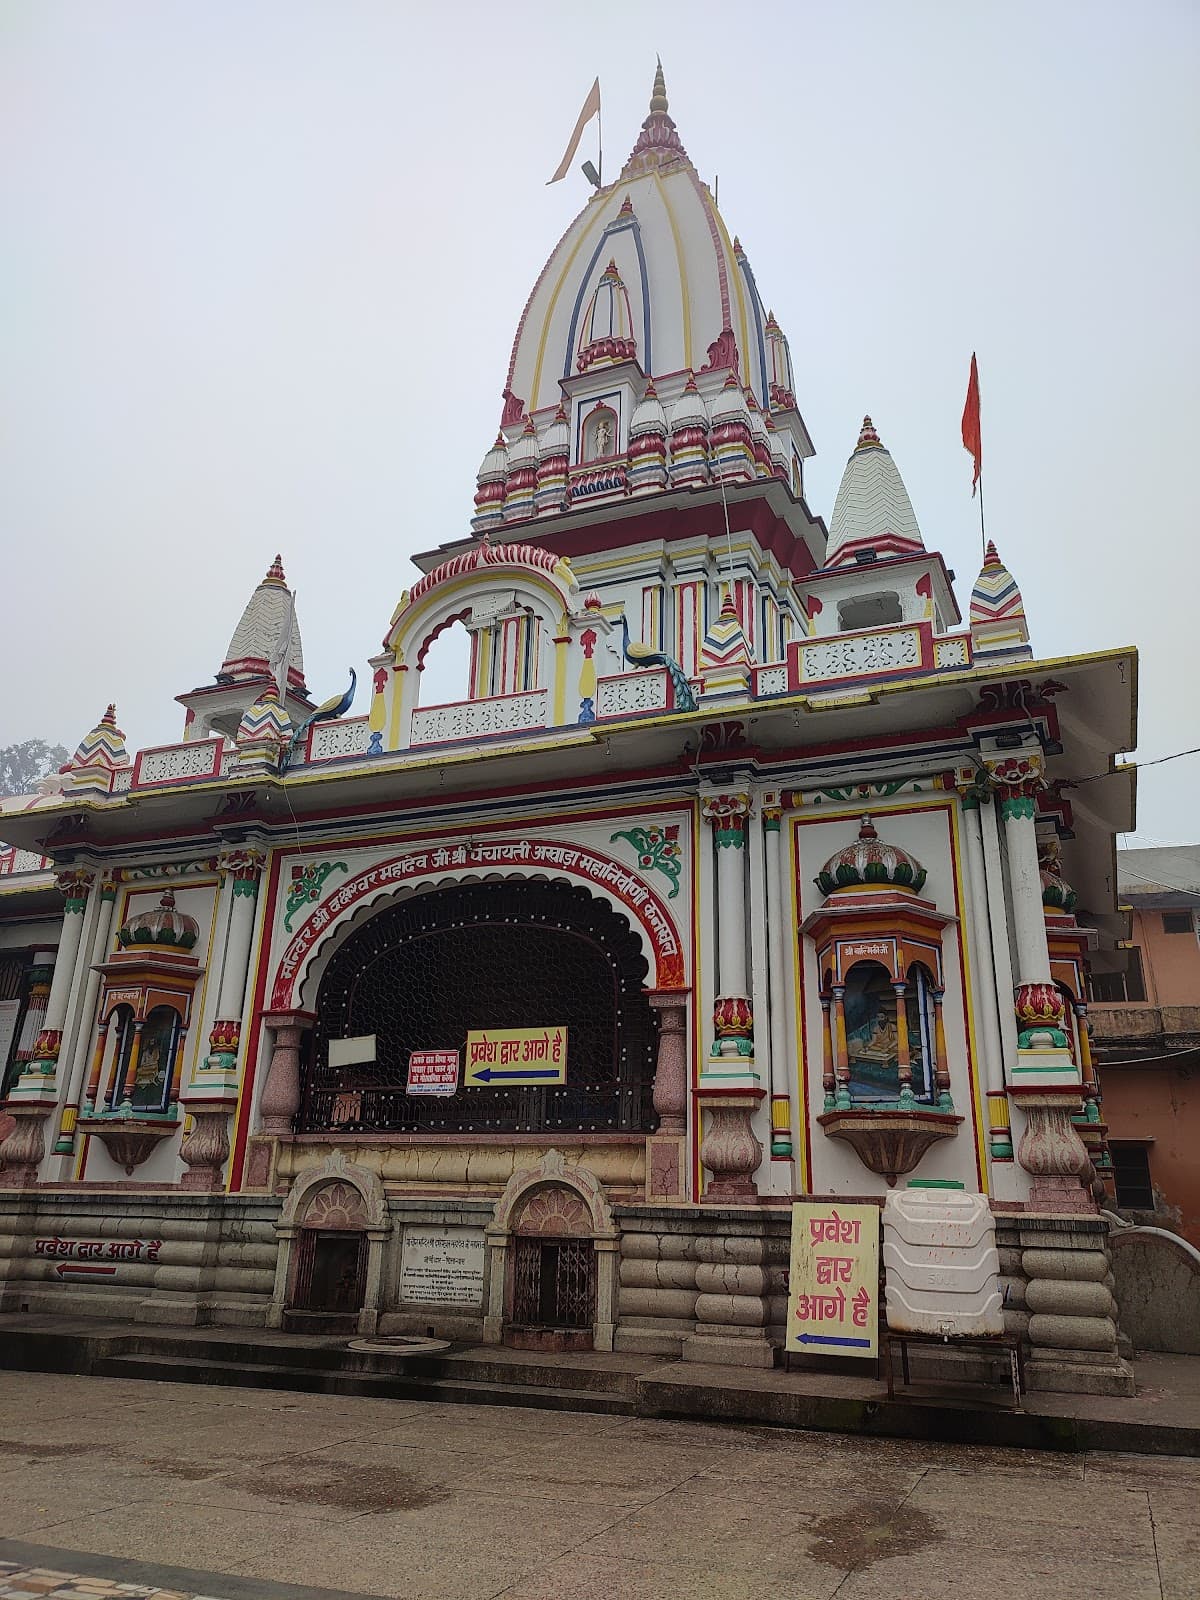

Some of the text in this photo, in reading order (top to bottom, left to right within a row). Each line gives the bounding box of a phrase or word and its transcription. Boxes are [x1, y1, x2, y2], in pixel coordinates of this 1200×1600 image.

[312, 905, 331, 931] श्री
[379, 855, 428, 880] महादेव
[470, 841, 531, 861] पंचायती
[530, 845, 582, 869] अखाड़ा
[580, 854, 649, 907] महानिर्वाणी
[645, 899, 678, 957] कनखल
[471, 1034, 498, 1067] प्रवेश
[500, 1040, 521, 1065] द्वार
[522, 1031, 550, 1062] आगे
[34, 1235, 77, 1256] प्रवेश
[106, 1239, 144, 1259] आगे
[809, 1209, 862, 1248] प्रवेश
[815, 1256, 854, 1285] द्वार
[795, 1286, 871, 1327] आगे है
